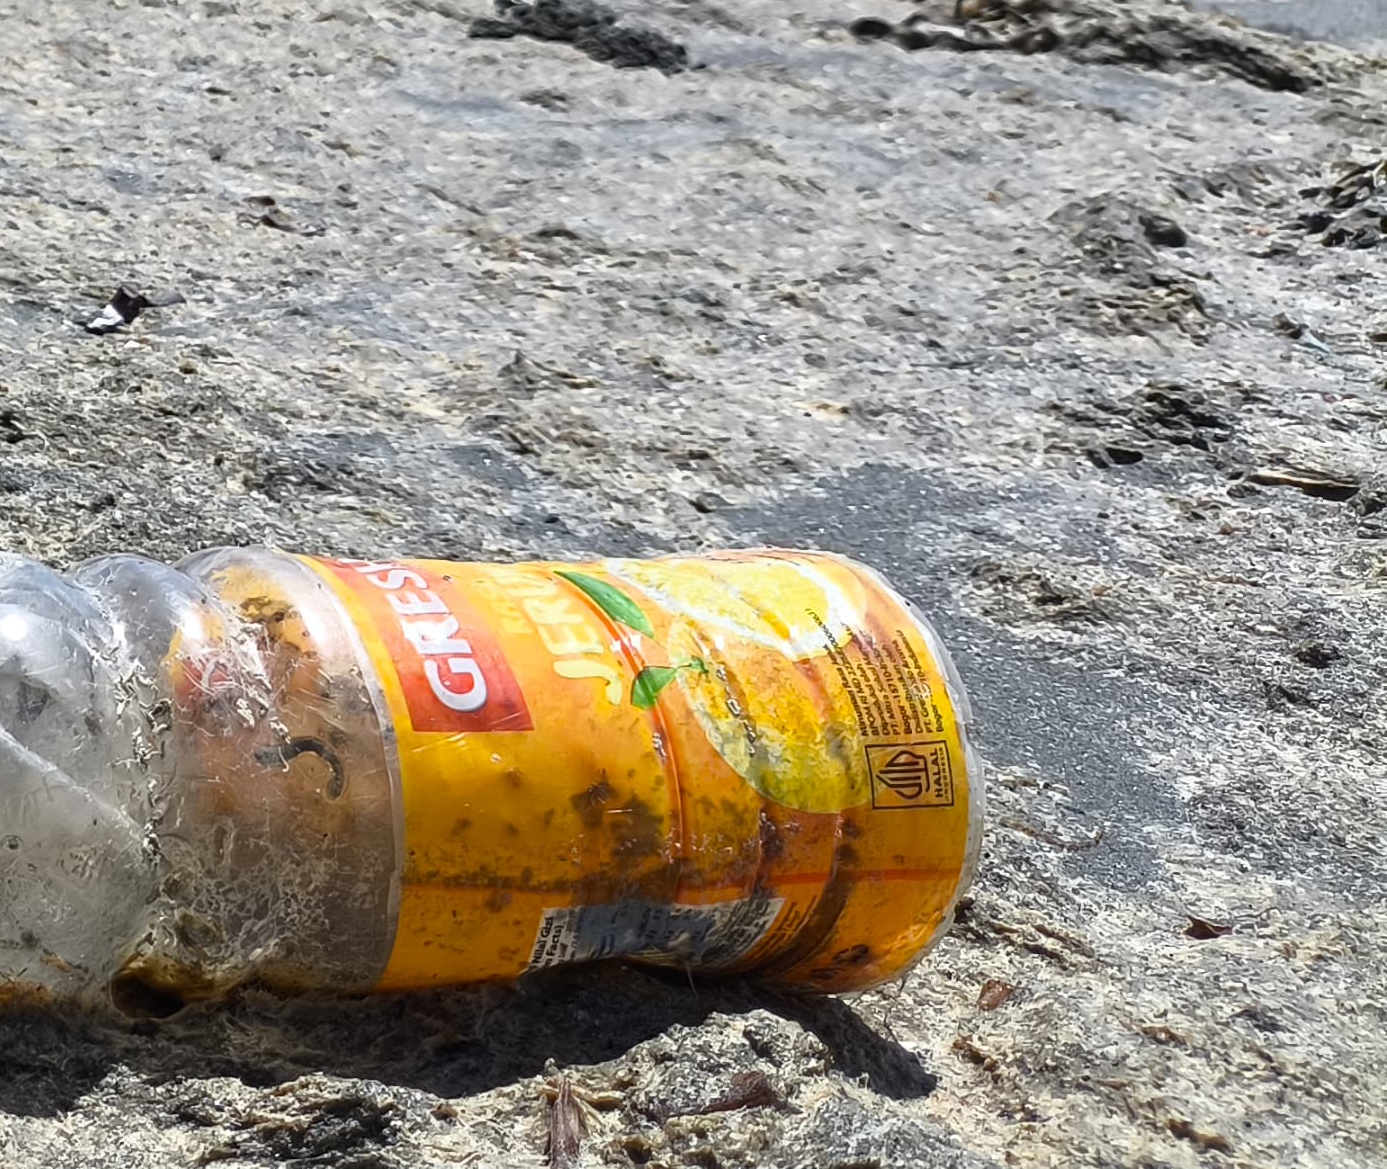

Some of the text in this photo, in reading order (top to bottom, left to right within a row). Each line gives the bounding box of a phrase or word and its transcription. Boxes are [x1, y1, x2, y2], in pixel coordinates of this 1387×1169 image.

[891, 639, 911, 670] Aroma
[851, 677, 865, 694] MD
[847, 690, 869, 736] Minuman
[864, 706, 880, 736] BPOM
[882, 694, 896, 720] Mitra
[930, 748, 944, 798] HALAL
[546, 924, 565, 957] Facts)
